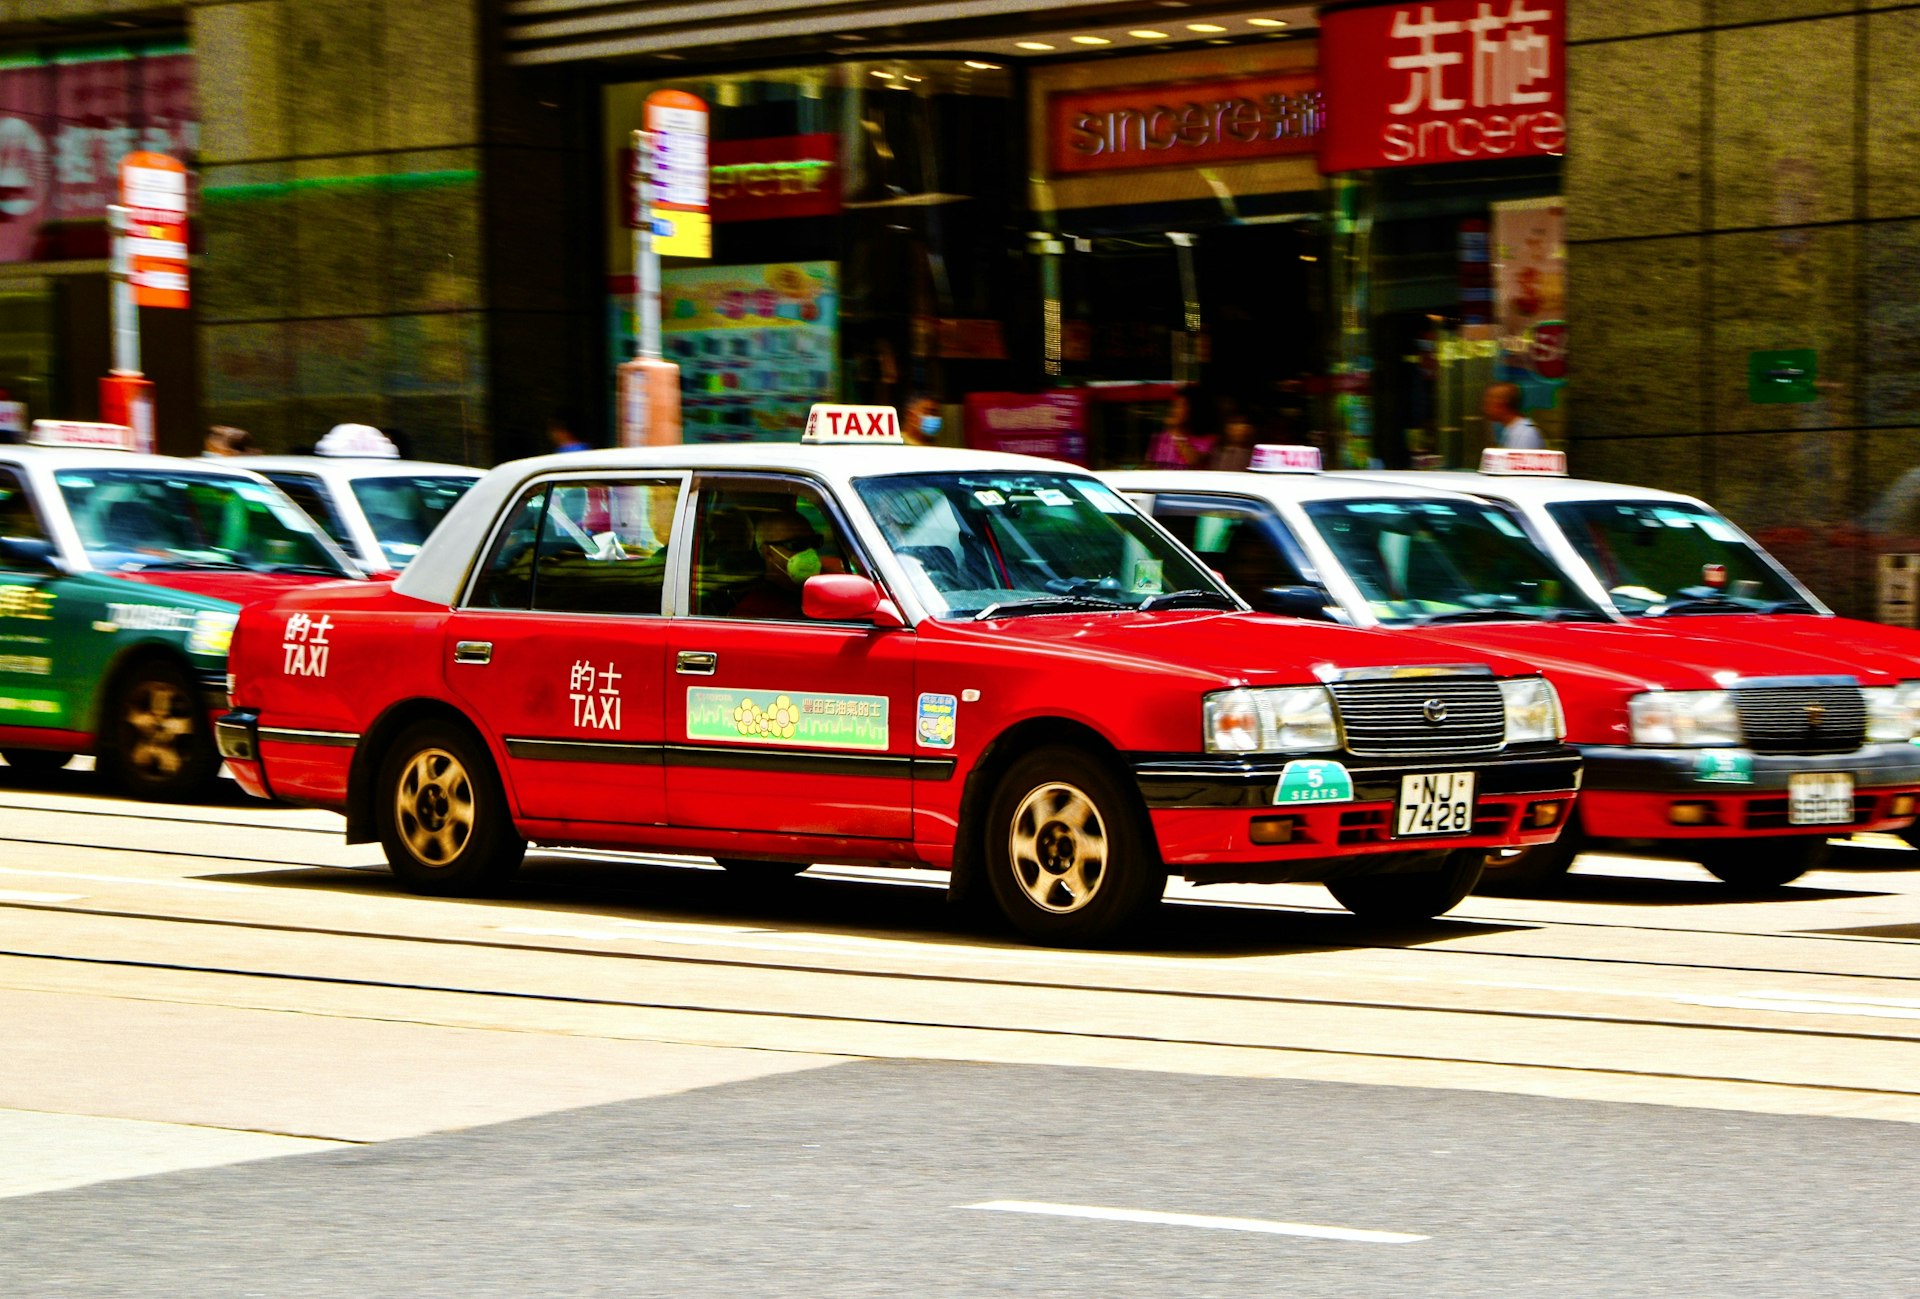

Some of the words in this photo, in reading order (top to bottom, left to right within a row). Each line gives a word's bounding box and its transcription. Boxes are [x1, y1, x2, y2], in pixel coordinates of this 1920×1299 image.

[1388, 0, 1551, 115] 先施
[1073, 98, 1261, 156] sincere
[826, 412, 895, 436] TAXI
[284, 613, 334, 644] 的士
[282, 643, 330, 678] TAXI
[569, 659, 622, 695] 的士
[569, 693, 621, 731] TAXI
[1307, 768, 1324, 788] 5
[1422, 775, 1455, 804] NJ
[1291, 788, 1339, 801] SEATS
[1405, 801, 1466, 832] 7428
